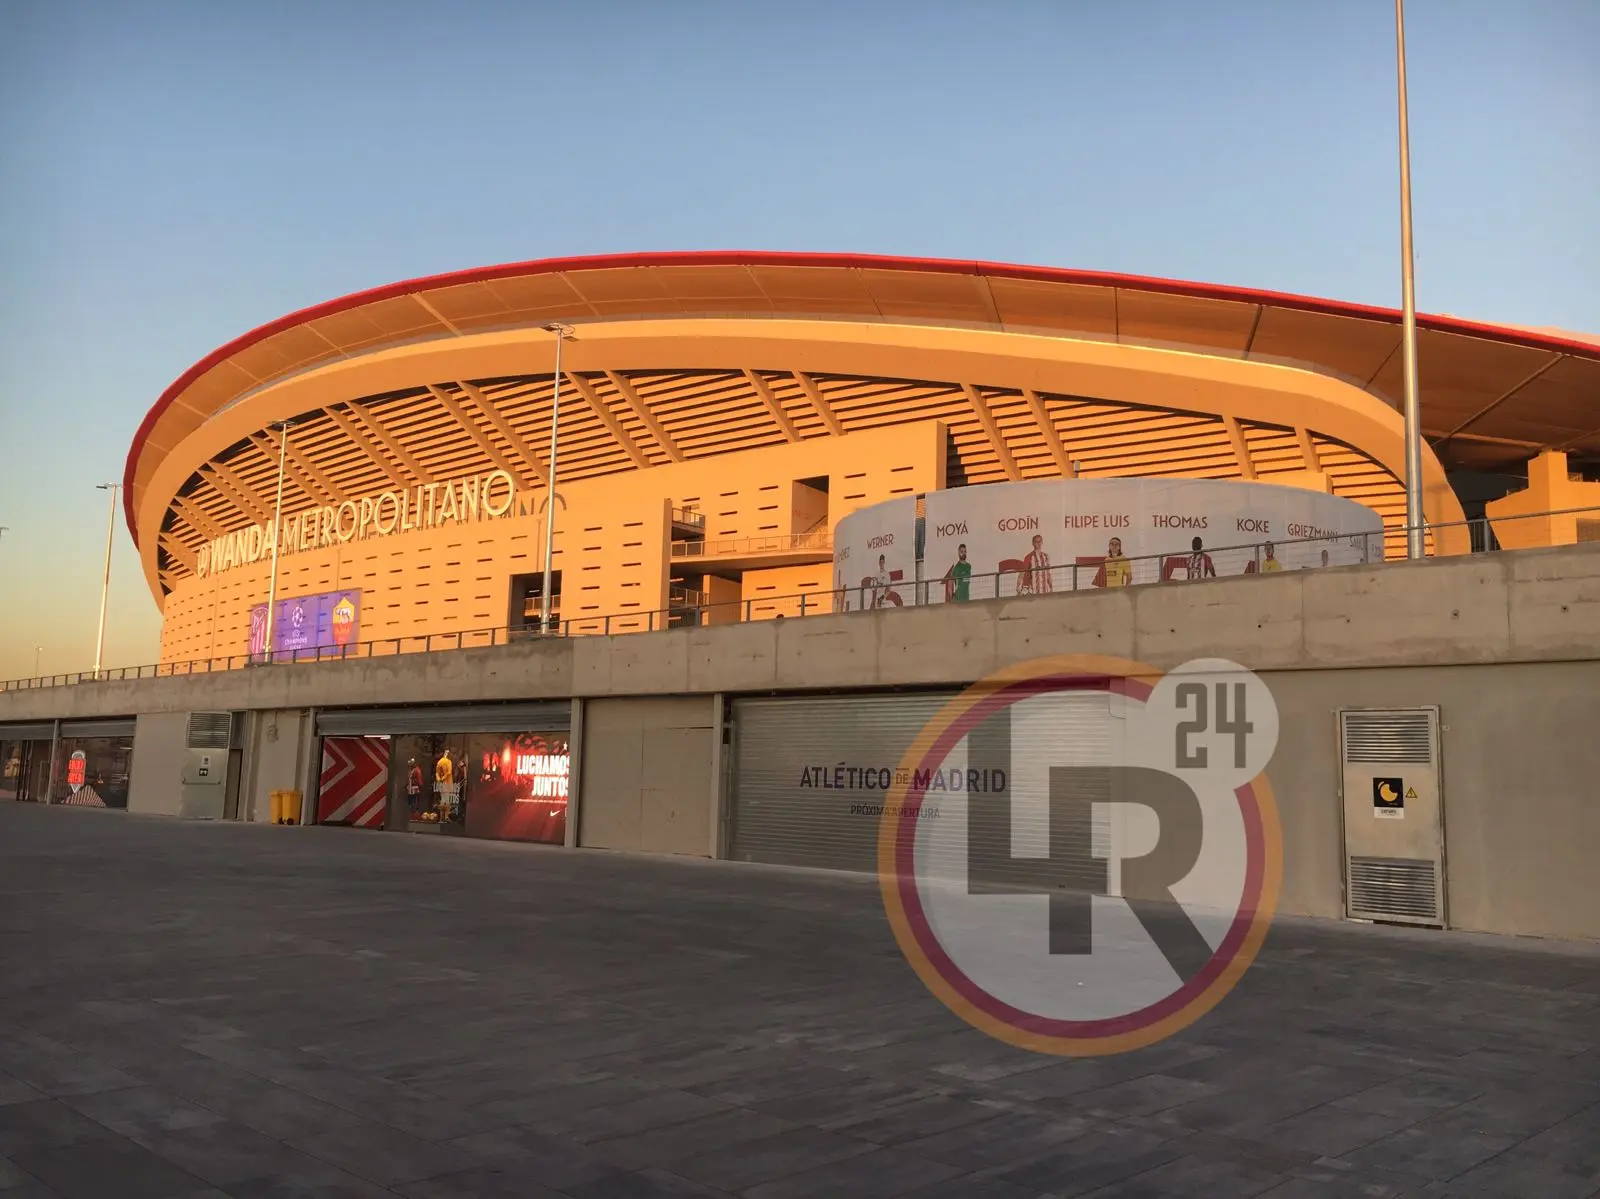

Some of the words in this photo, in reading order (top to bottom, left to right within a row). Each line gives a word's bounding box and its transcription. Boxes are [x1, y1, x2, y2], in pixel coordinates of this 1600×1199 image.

[210, 519, 276, 574] WANDA
[282, 470, 514, 553] METROPOLITANO
[936, 520, 969, 538] MOYÁ
[998, 515, 1039, 531] GODÍN
[1064, 515, 1099, 529] FILIPE
[1103, 514, 1130, 528] LUIS
[1152, 515, 1208, 529] THOMAS
[1236, 518, 1270, 533] KOKE
[866, 533, 894, 549] WERNER
[1287, 523, 1338, 543] GRIEZMANN
[800, 762, 891, 789] ATLÉTICO
[896, 772, 909, 785] DE
[913, 768, 1007, 793] MADRID
[850, 802, 890, 816] PRÓXIMA
[892, 805, 940, 819] APERTURA
